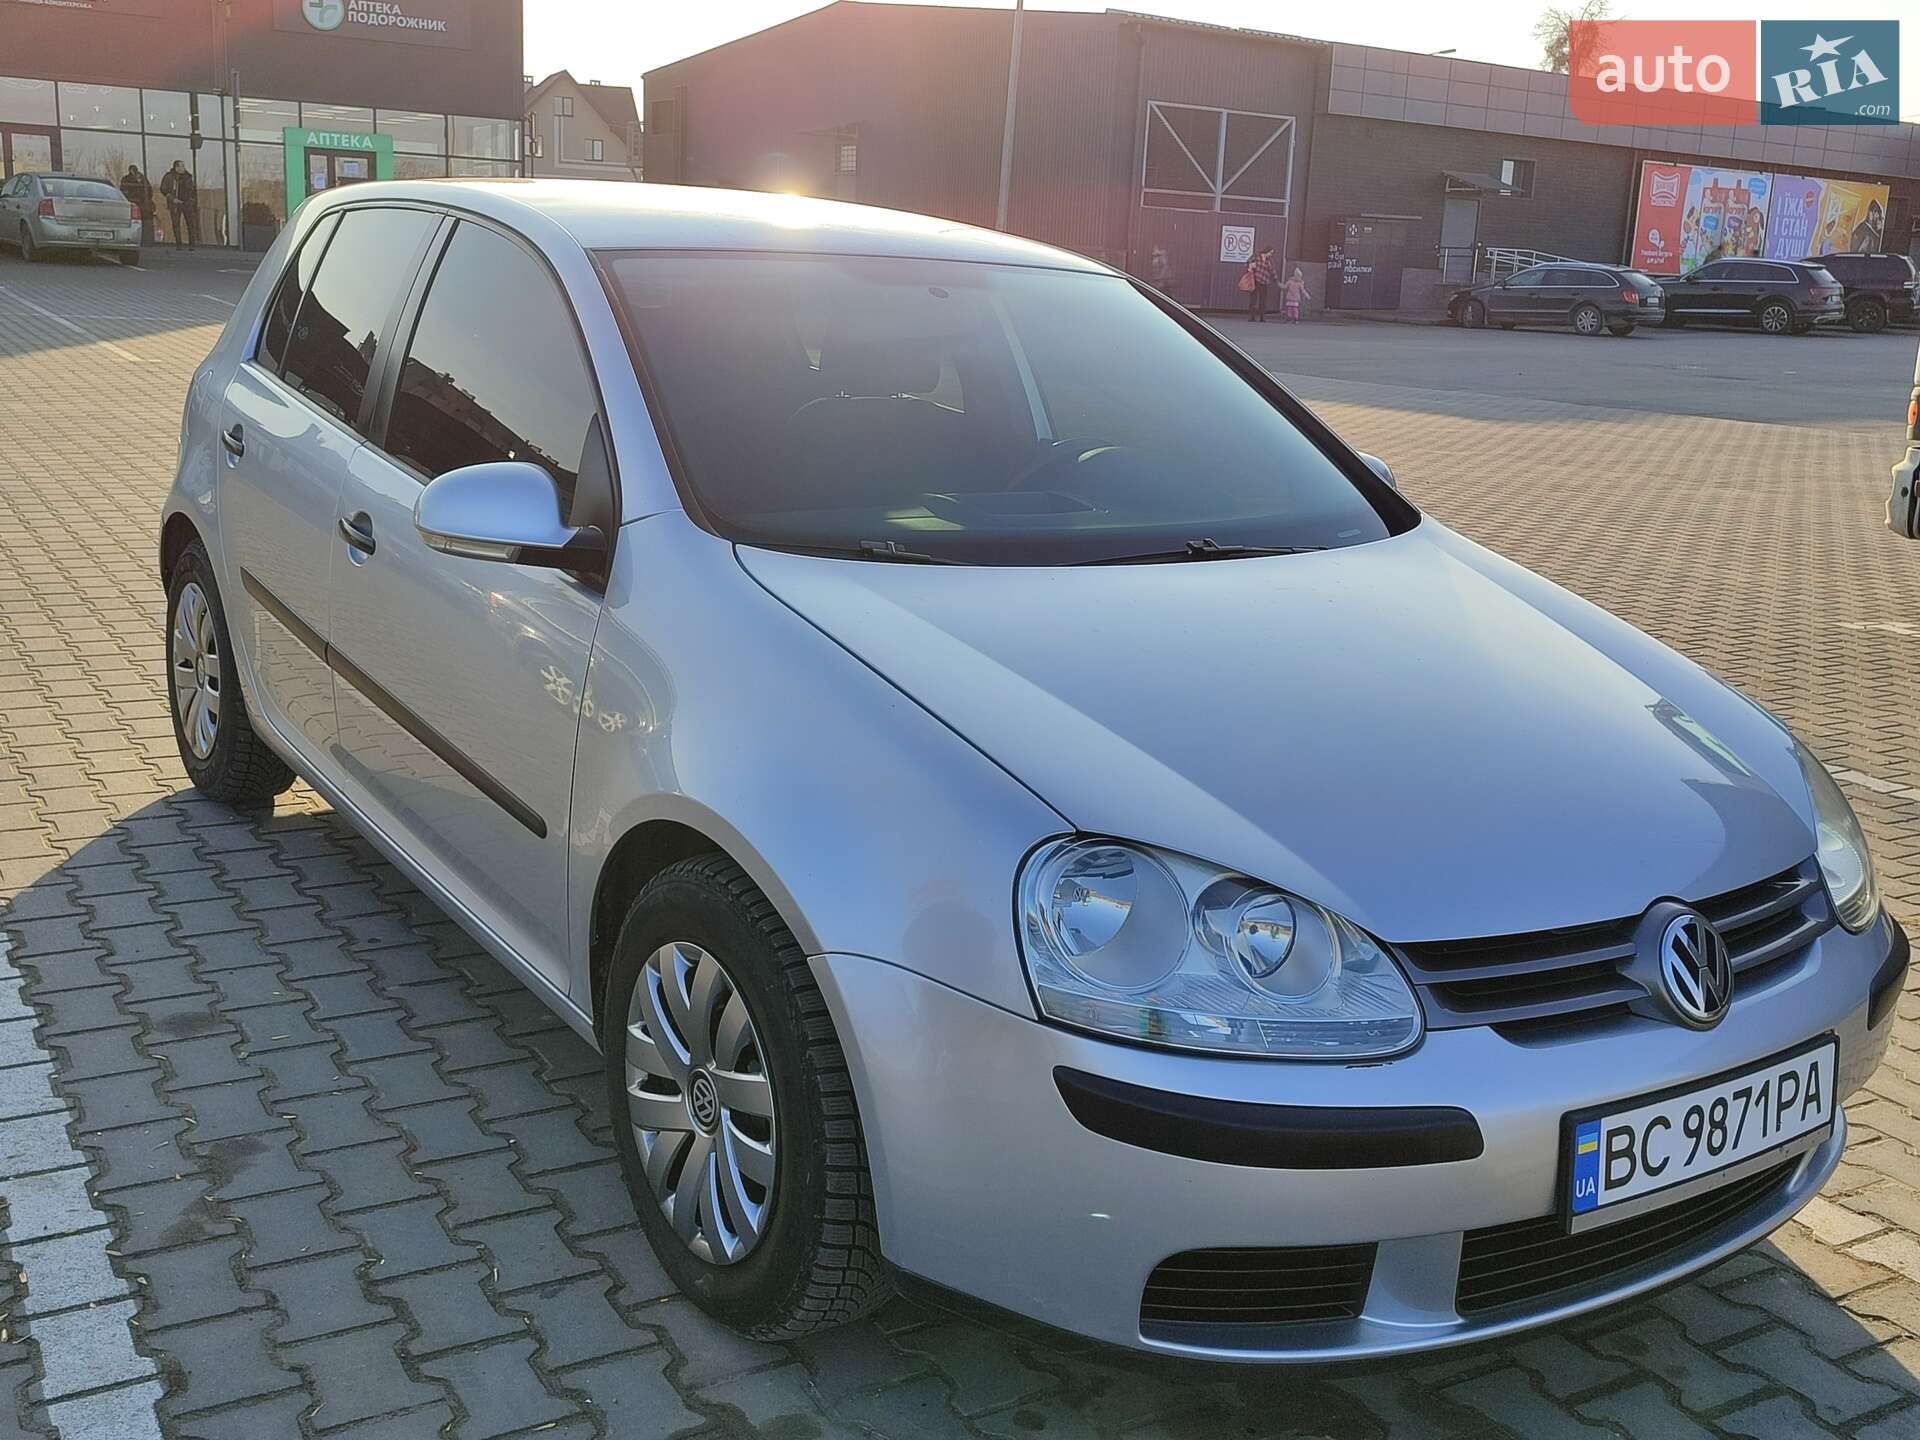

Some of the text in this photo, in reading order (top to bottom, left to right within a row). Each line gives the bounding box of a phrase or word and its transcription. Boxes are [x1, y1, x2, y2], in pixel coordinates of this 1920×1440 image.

[347, 0, 402, 15] АПТЕКА
[347, 11, 447, 32] ПОДОРОЖНИК
[306, 131, 374, 149] АПТЕКА
[1781, 217, 1809, 238] СТАН
[1775, 238, 1805, 259] ДУШІ
[1343, 275, 1358, 284] 24/7
[1604, 1115, 1671, 1191] BC
[1576, 1180, 1596, 1198] UA
